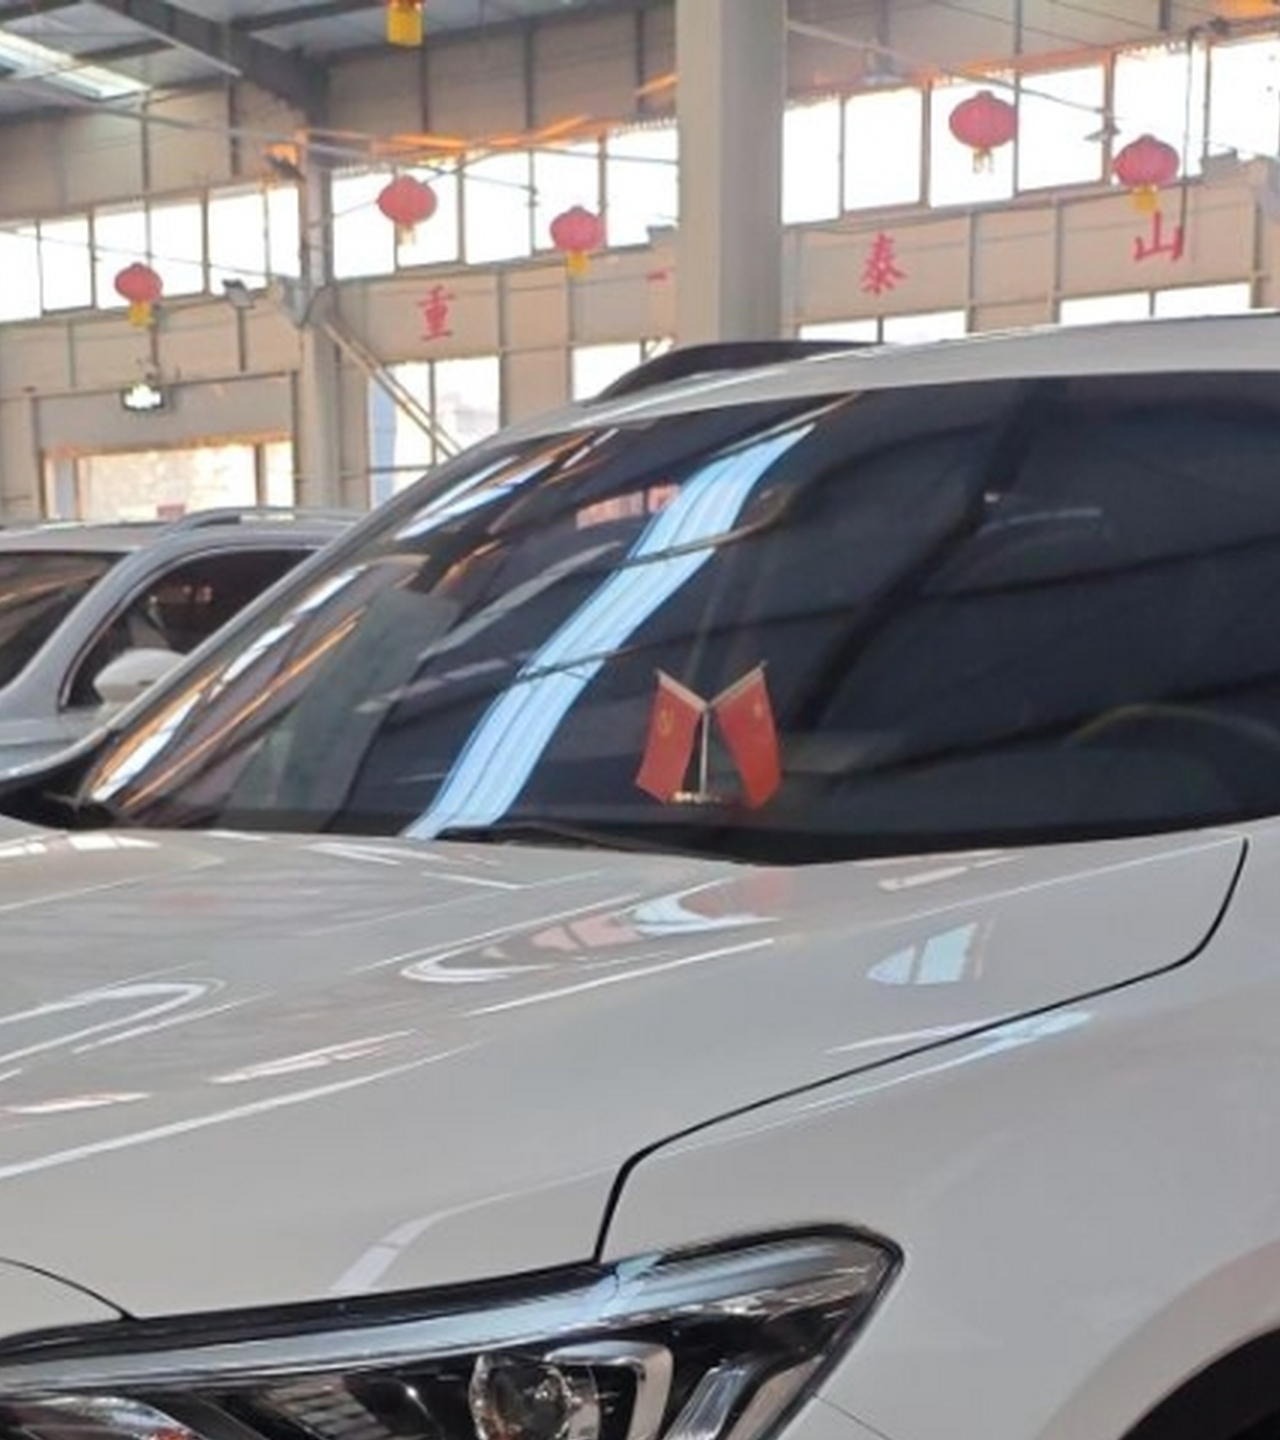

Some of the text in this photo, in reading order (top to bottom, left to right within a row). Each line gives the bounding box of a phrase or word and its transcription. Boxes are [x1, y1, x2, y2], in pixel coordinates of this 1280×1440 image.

[860, 232, 907, 295] 泰
[1133, 210, 1184, 262] 山
[418, 283, 455, 340] 重
